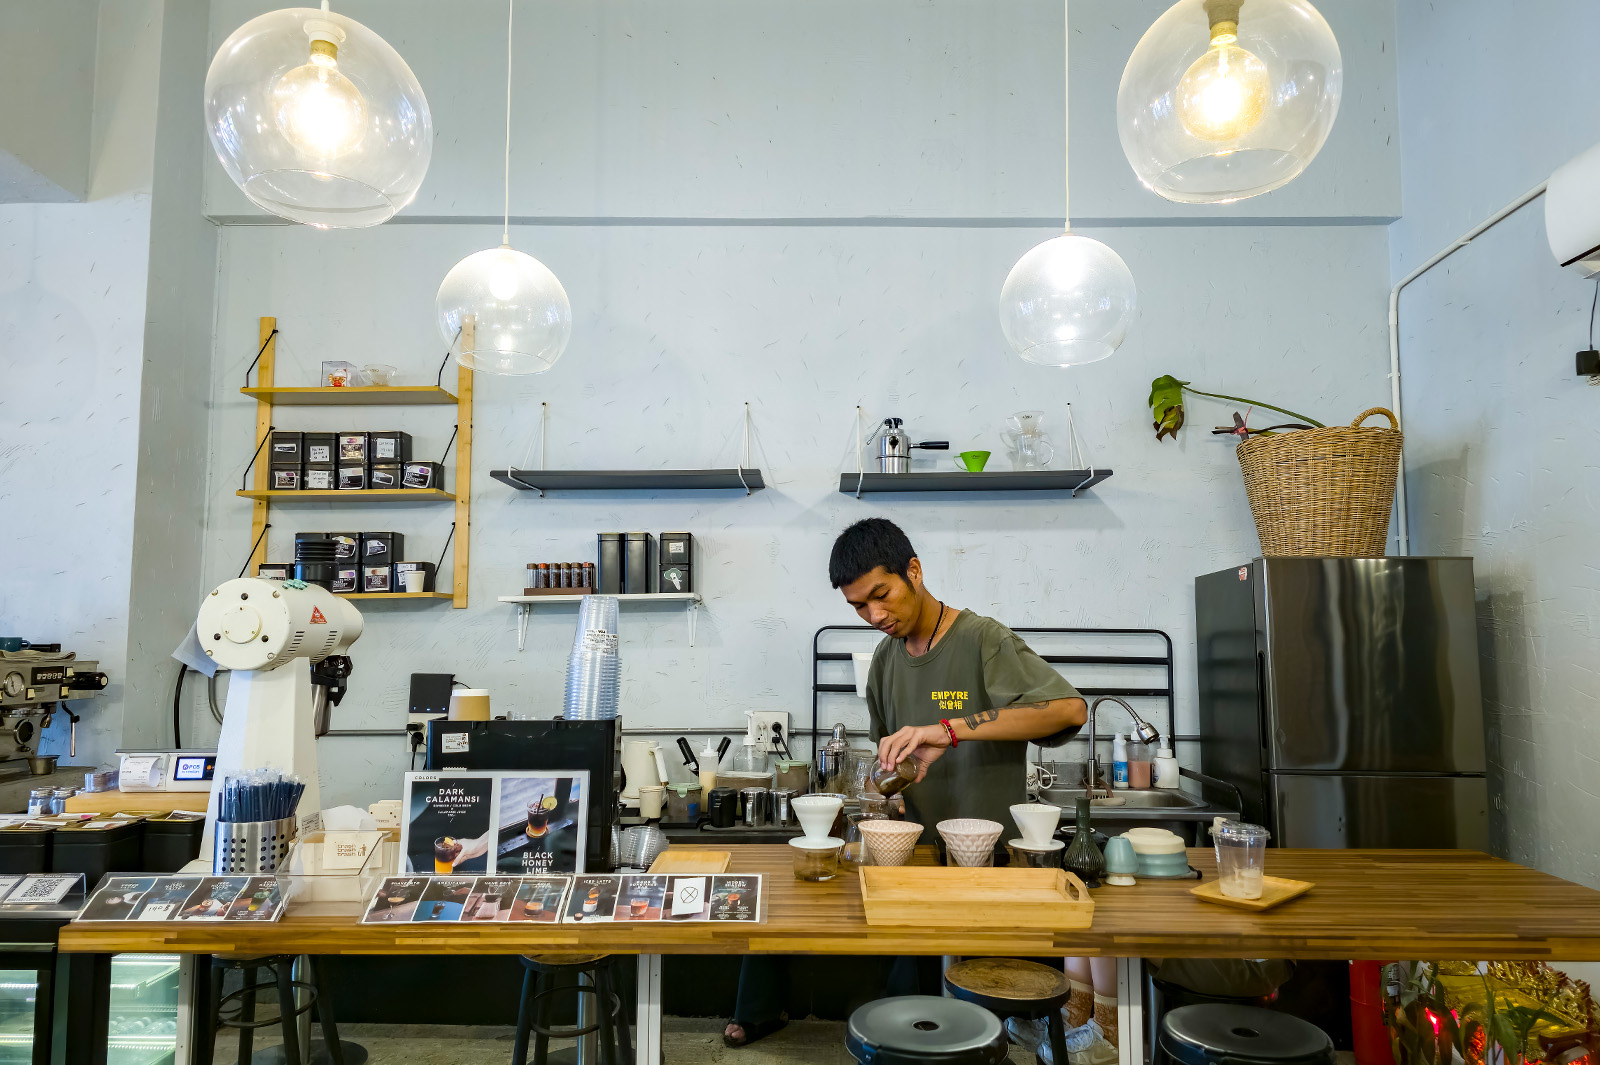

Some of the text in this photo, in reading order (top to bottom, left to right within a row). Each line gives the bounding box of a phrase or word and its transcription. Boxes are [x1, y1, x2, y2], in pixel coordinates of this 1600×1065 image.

[931, 691, 969, 700] EMPYRE
[438, 788, 465, 796] DARK
[522, 851, 553, 859] BLACK
[521, 859, 554, 867] HONEY
